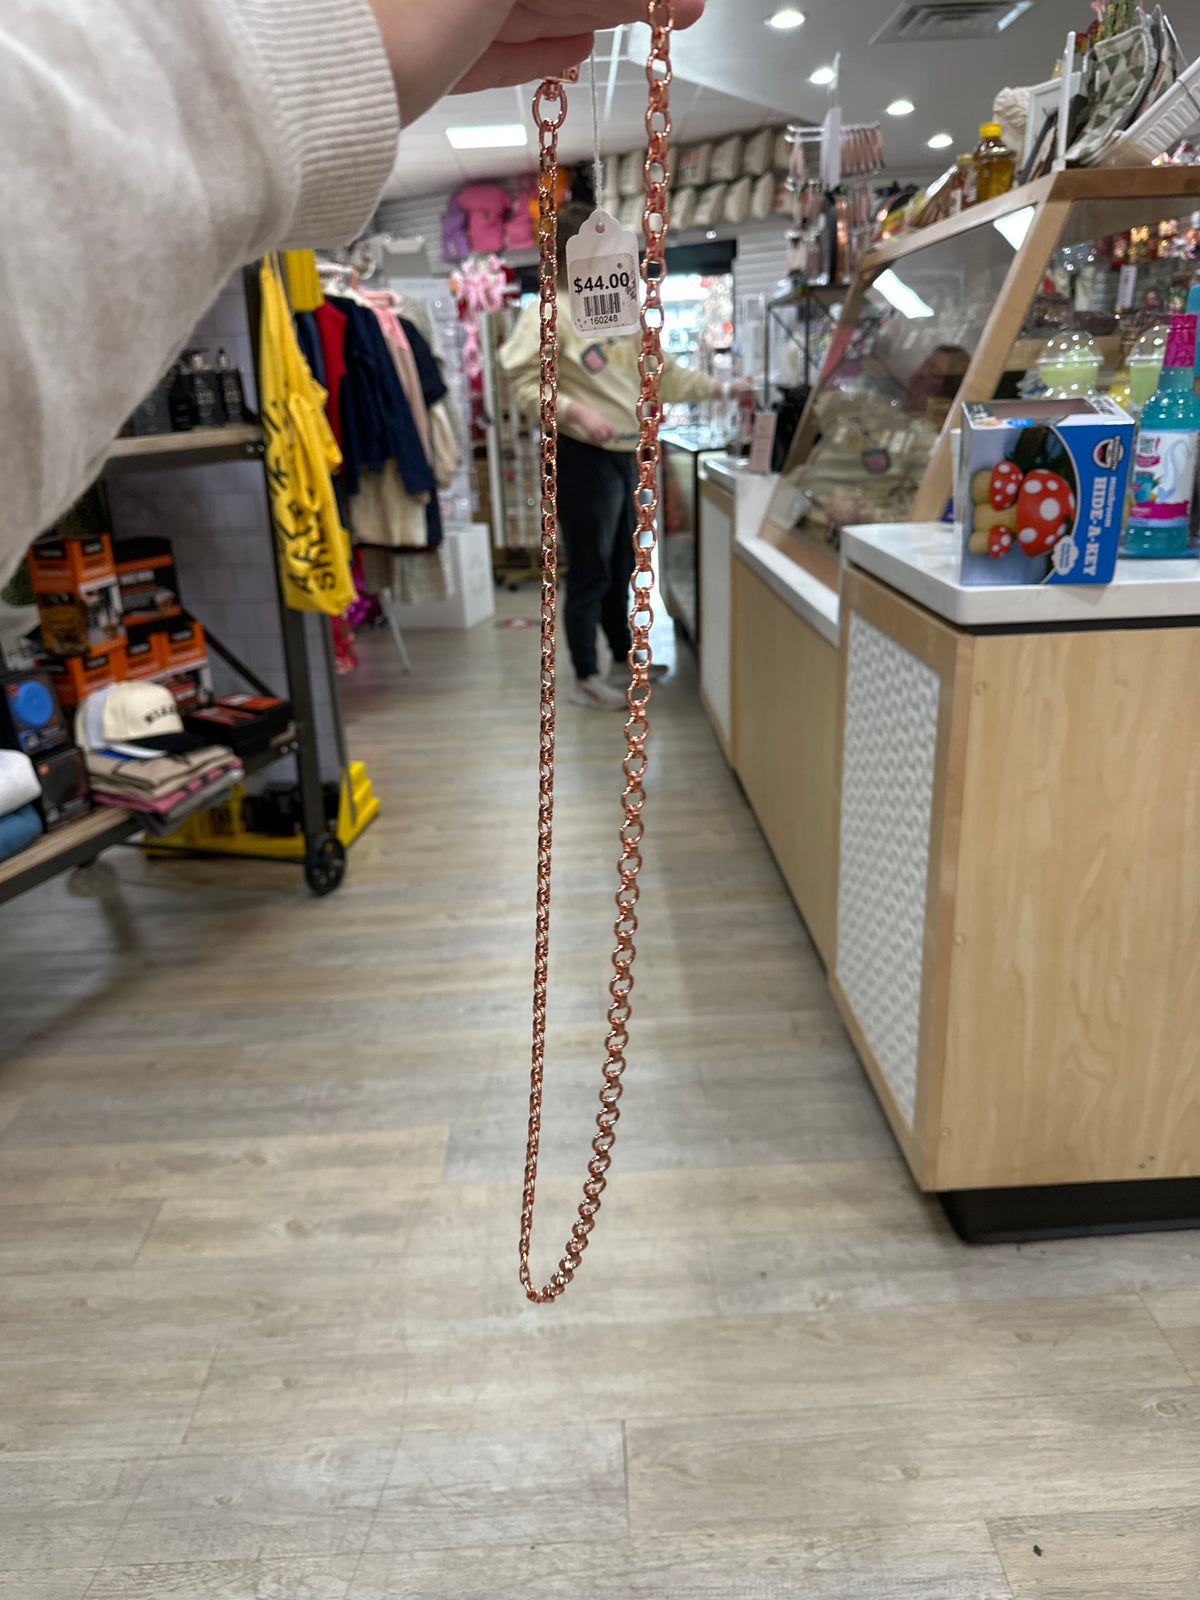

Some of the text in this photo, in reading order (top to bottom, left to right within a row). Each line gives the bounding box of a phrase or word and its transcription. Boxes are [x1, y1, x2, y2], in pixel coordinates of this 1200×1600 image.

[573, 272, 629, 294] $44.00
[590, 314, 618, 325] 160248
[1104, 476, 1117, 527] mushroom
